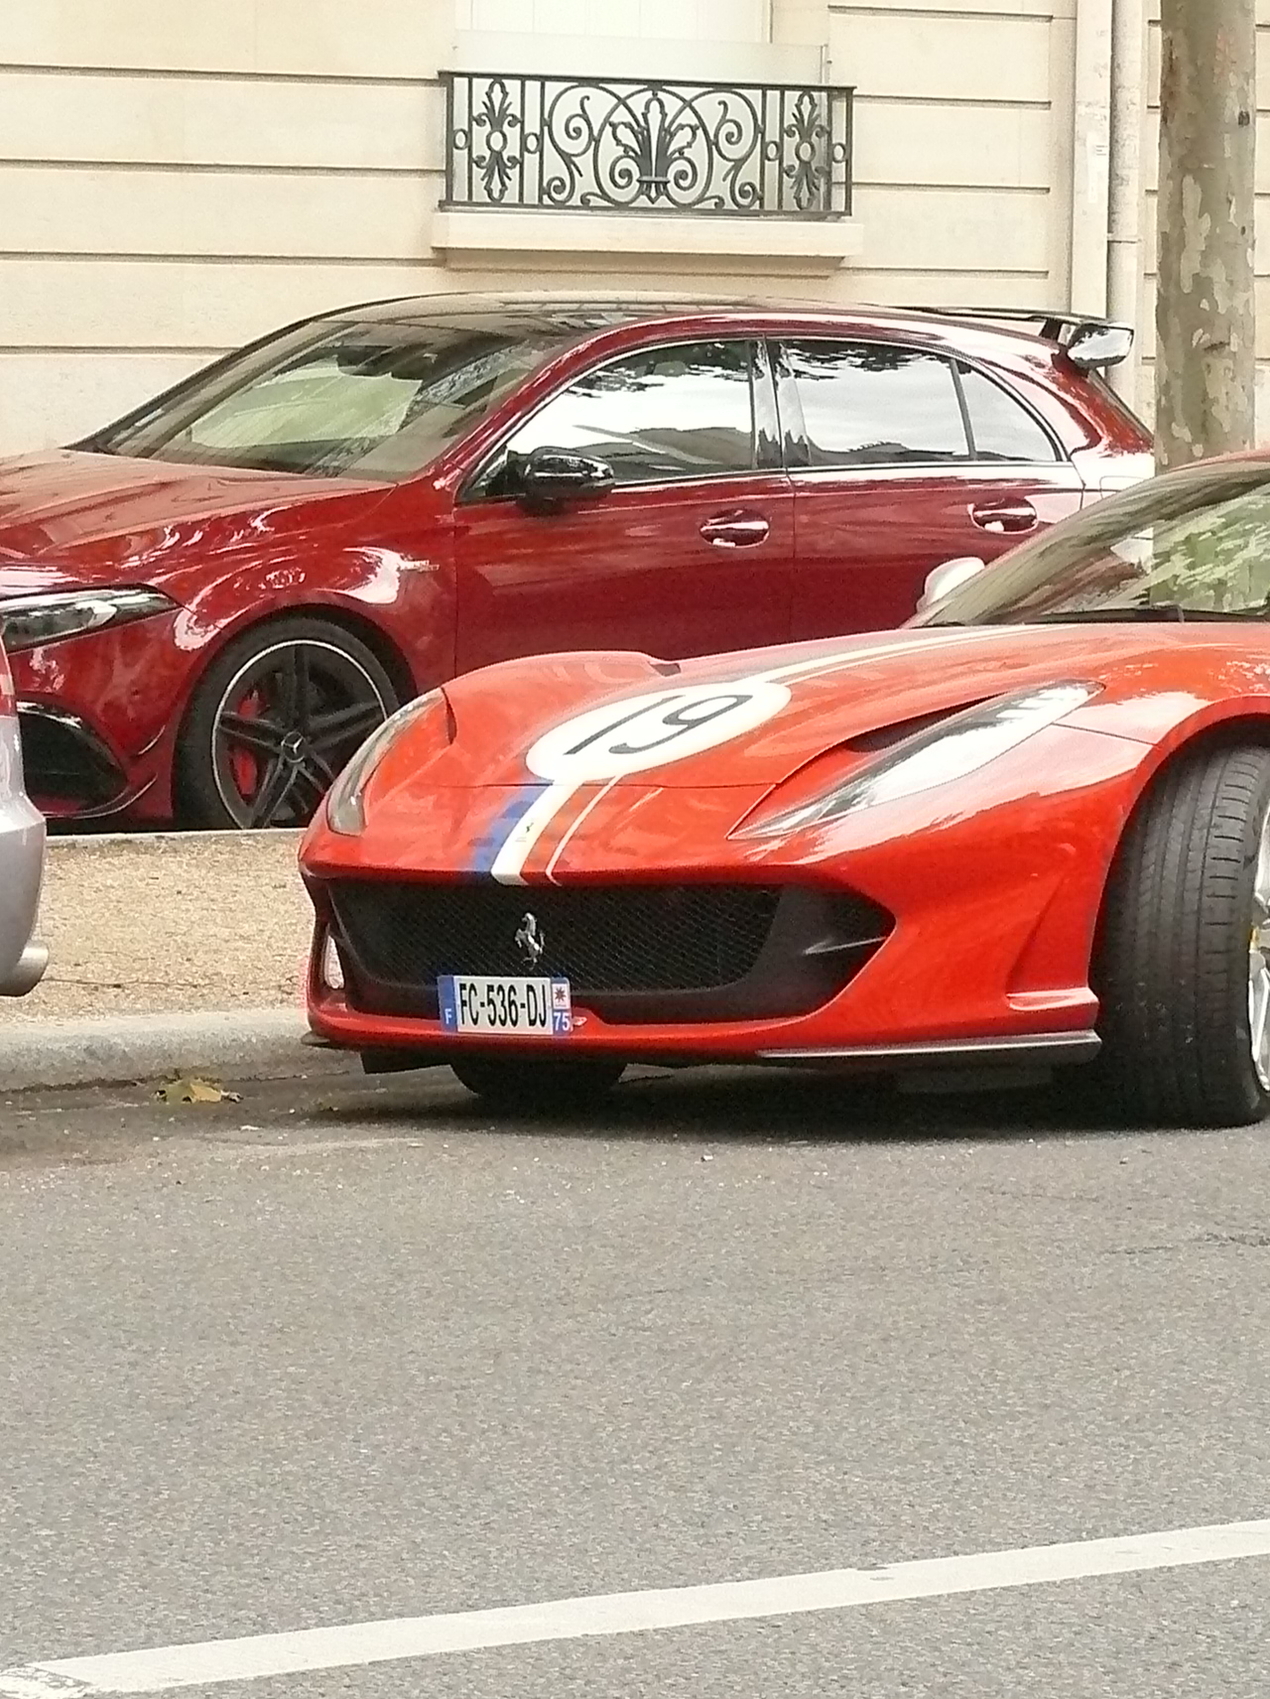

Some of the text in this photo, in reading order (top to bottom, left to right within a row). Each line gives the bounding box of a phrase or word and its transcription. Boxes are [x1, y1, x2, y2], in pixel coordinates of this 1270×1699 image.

[563, 694, 753, 755] 19
[444, 1008, 453, 1025] F
[459, 982, 547, 1028] FC-536-DJ
[553, 1011, 570, 1032] 75
